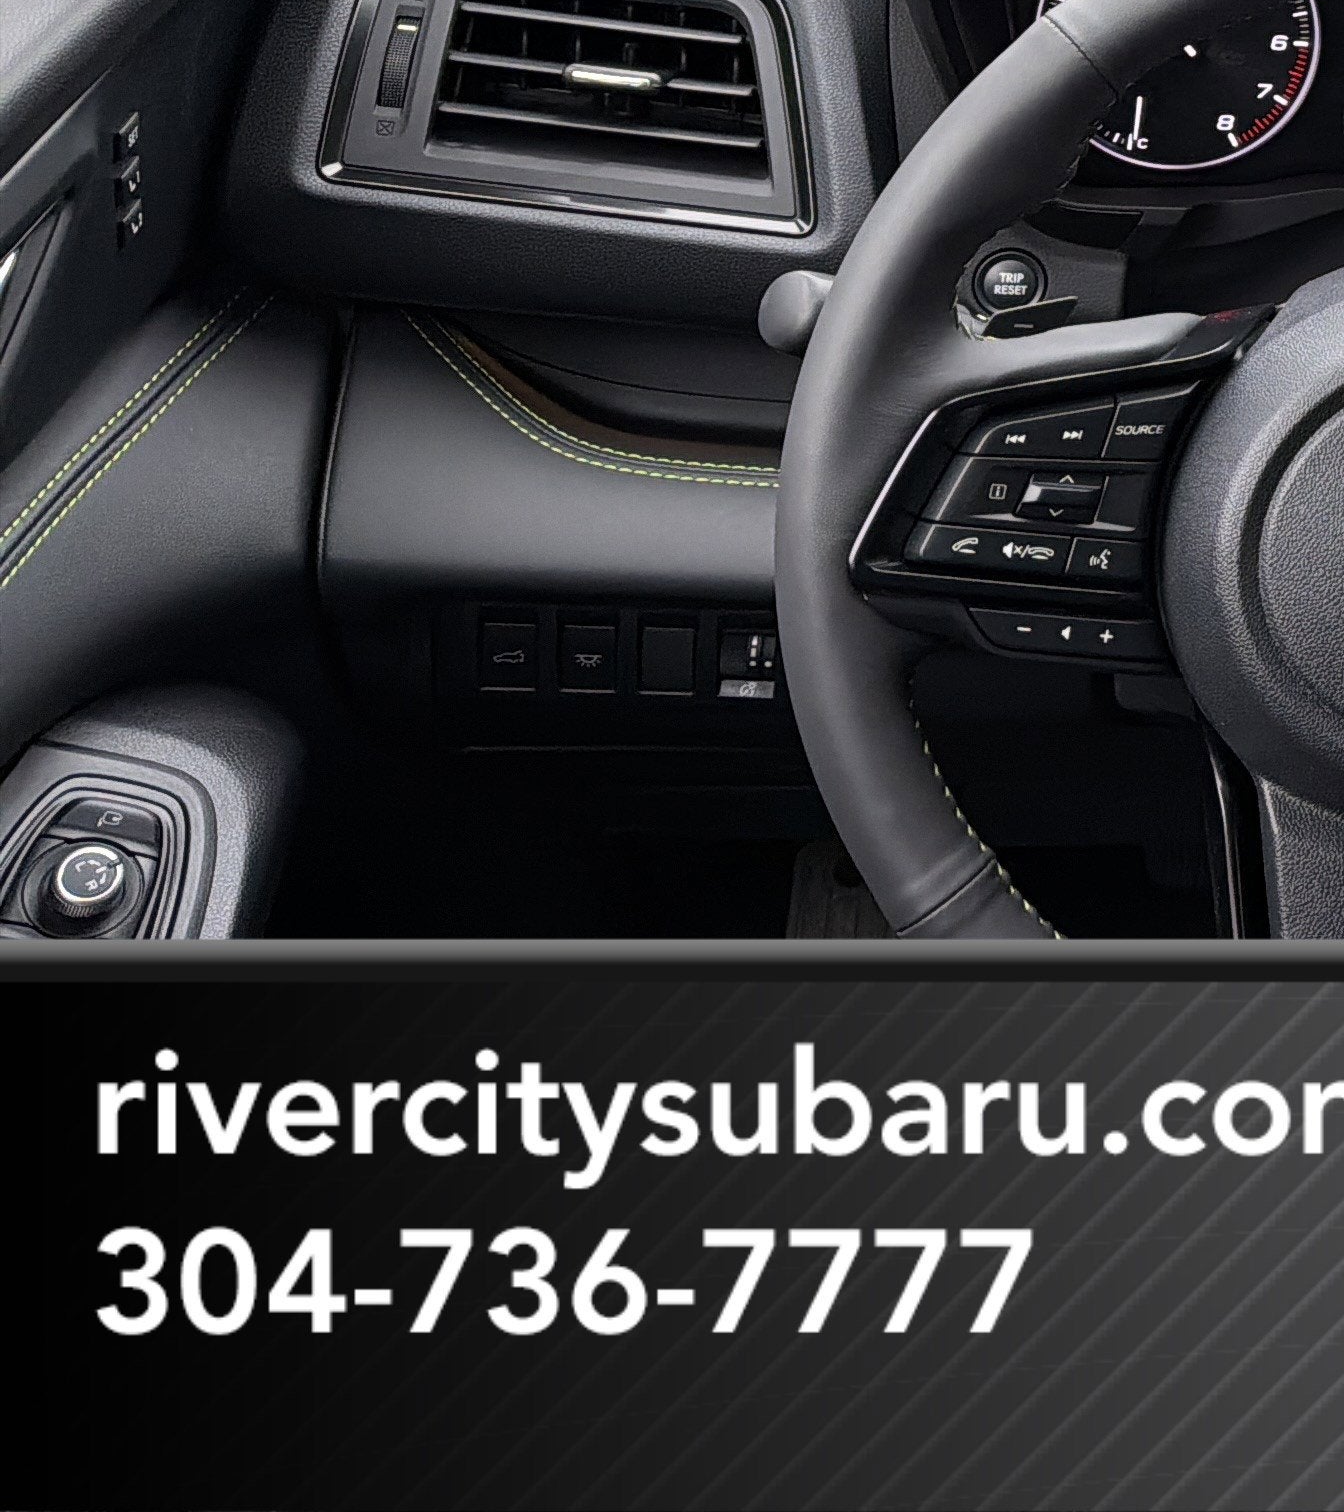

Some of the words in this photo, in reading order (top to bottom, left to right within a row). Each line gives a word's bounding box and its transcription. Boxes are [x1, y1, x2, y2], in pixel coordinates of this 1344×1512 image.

[1270, 34, 1289, 51] 6
[1257, 83, 1273, 99] 7
[1216, 114, 1235, 131] 8
[1137, 138, 1149, 149] C
[999, 272, 1025, 283] TRIP
[994, 284, 1028, 297] RESET
[1115, 424, 1166, 436] SOURCE
